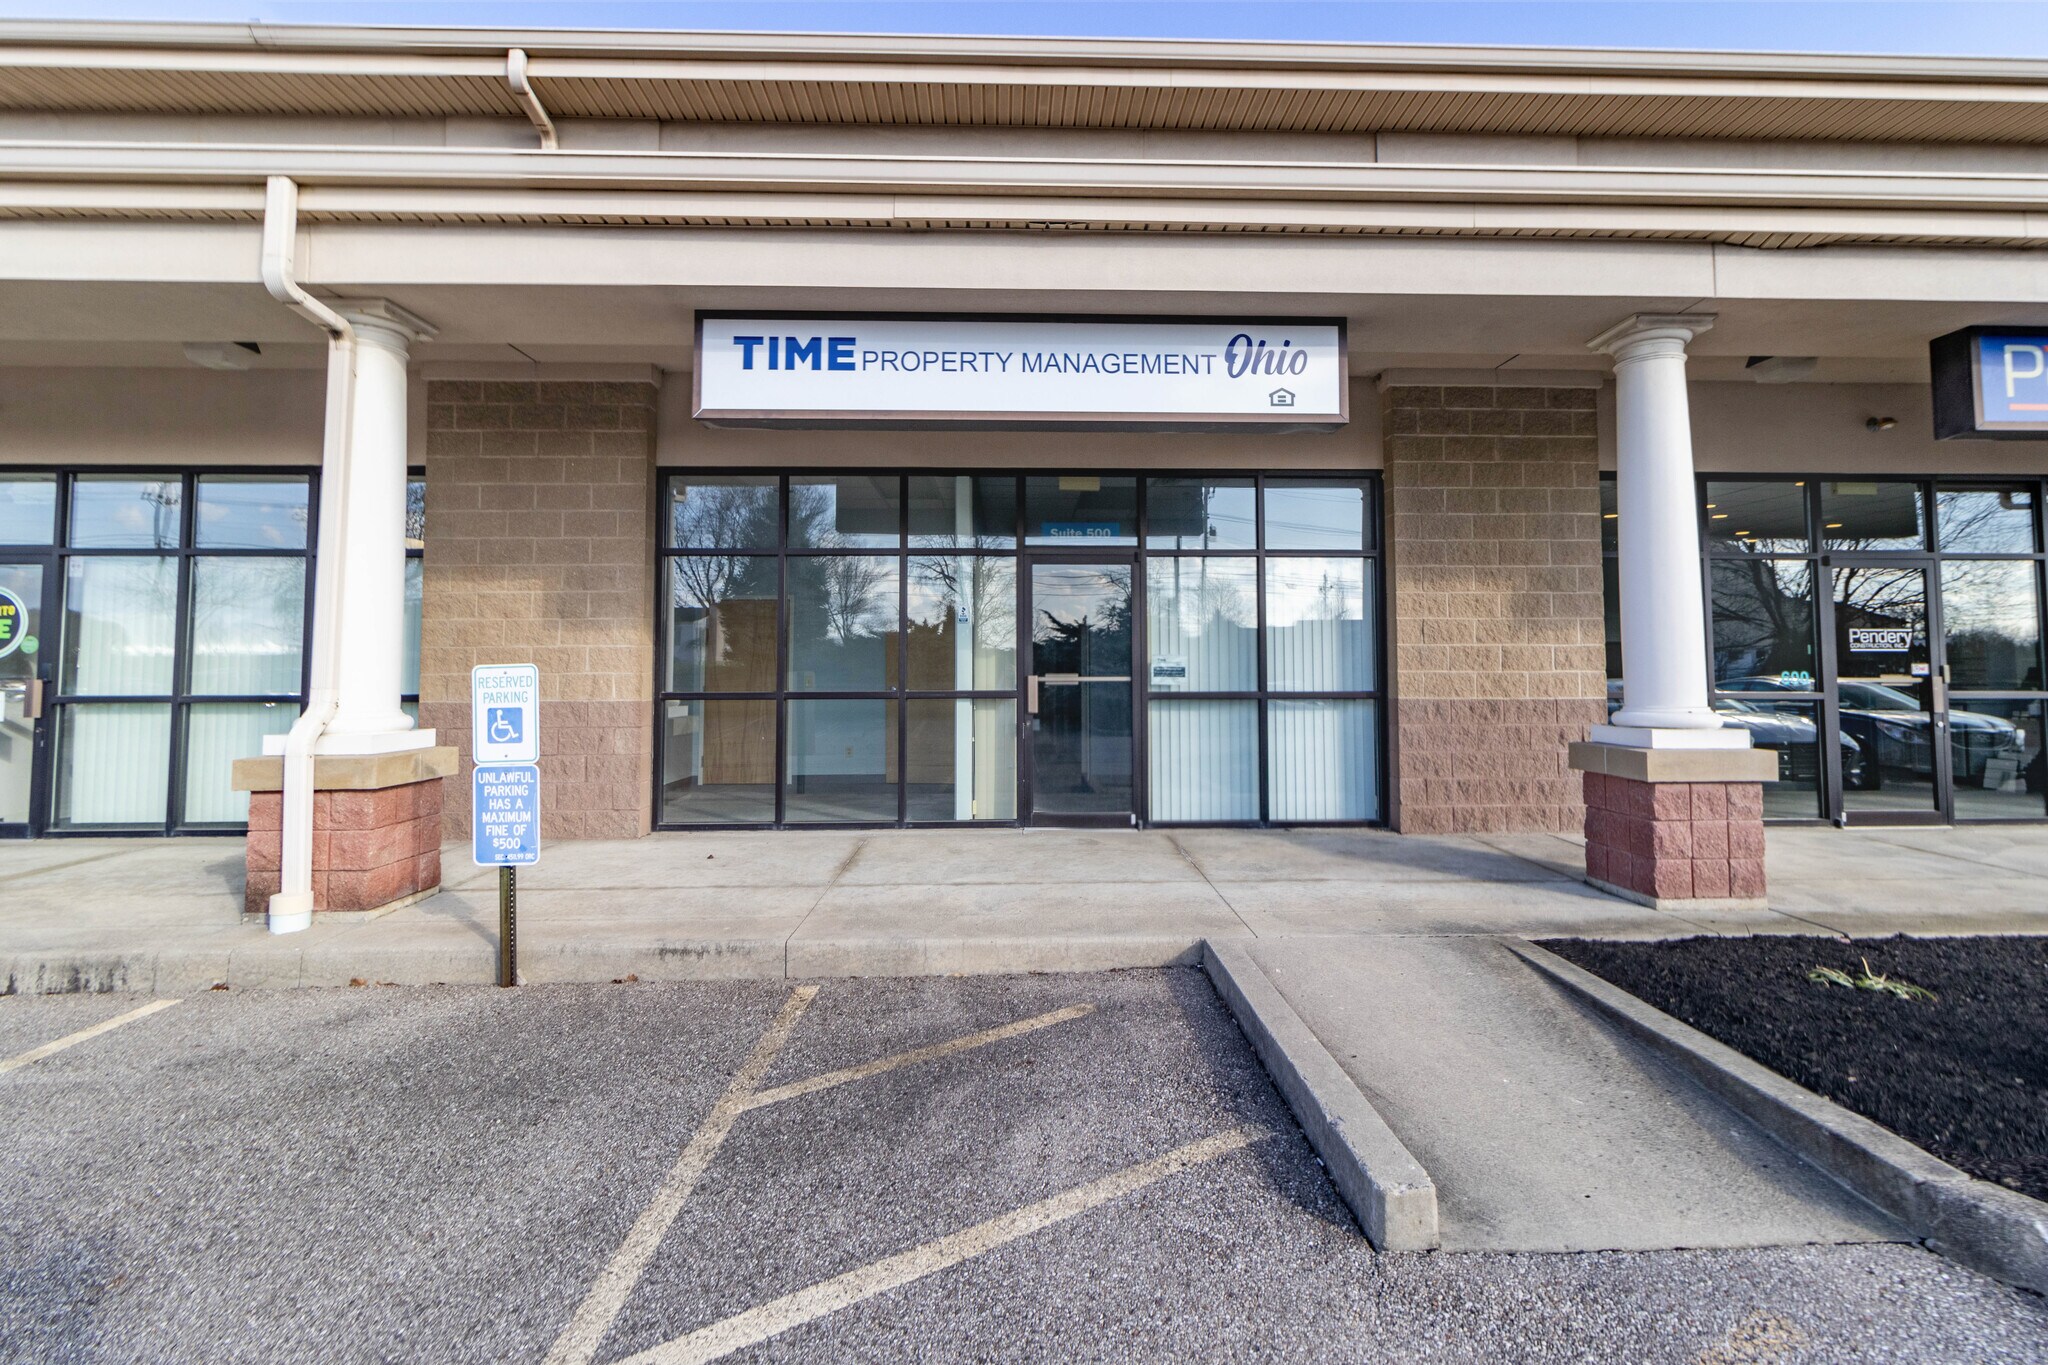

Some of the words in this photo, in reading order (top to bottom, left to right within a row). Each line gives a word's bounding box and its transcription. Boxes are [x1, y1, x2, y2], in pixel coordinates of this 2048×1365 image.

[733, 335, 857, 371] TIME
[862, 350, 1013, 373] PROPERTY
[1021, 352, 1217, 375] MANAGEMENT
[1224, 332, 1308, 380] Ohio
[2004, 344, 2048, 398] P
[1050, 528, 1082, 538] Suite
[1087, 528, 1111, 538] 500
[0, 605, 16, 616] TO
[1849, 628, 1912, 648] Pendery
[478, 675, 533, 689] RESERVED
[1781, 671, 1809, 686] 600
[483, 691, 528, 704] PARKING
[478, 772, 534, 784] UNLAWFUL
[484, 785, 528, 797] PARKING
[489, 798, 511, 810] HAS
[515, 798, 523, 809] A
[482, 811, 531, 823] MAXIMUM
[486, 825, 509, 836] FINE
[513, 824, 527, 836] OF
[492, 837, 520, 850] $500
